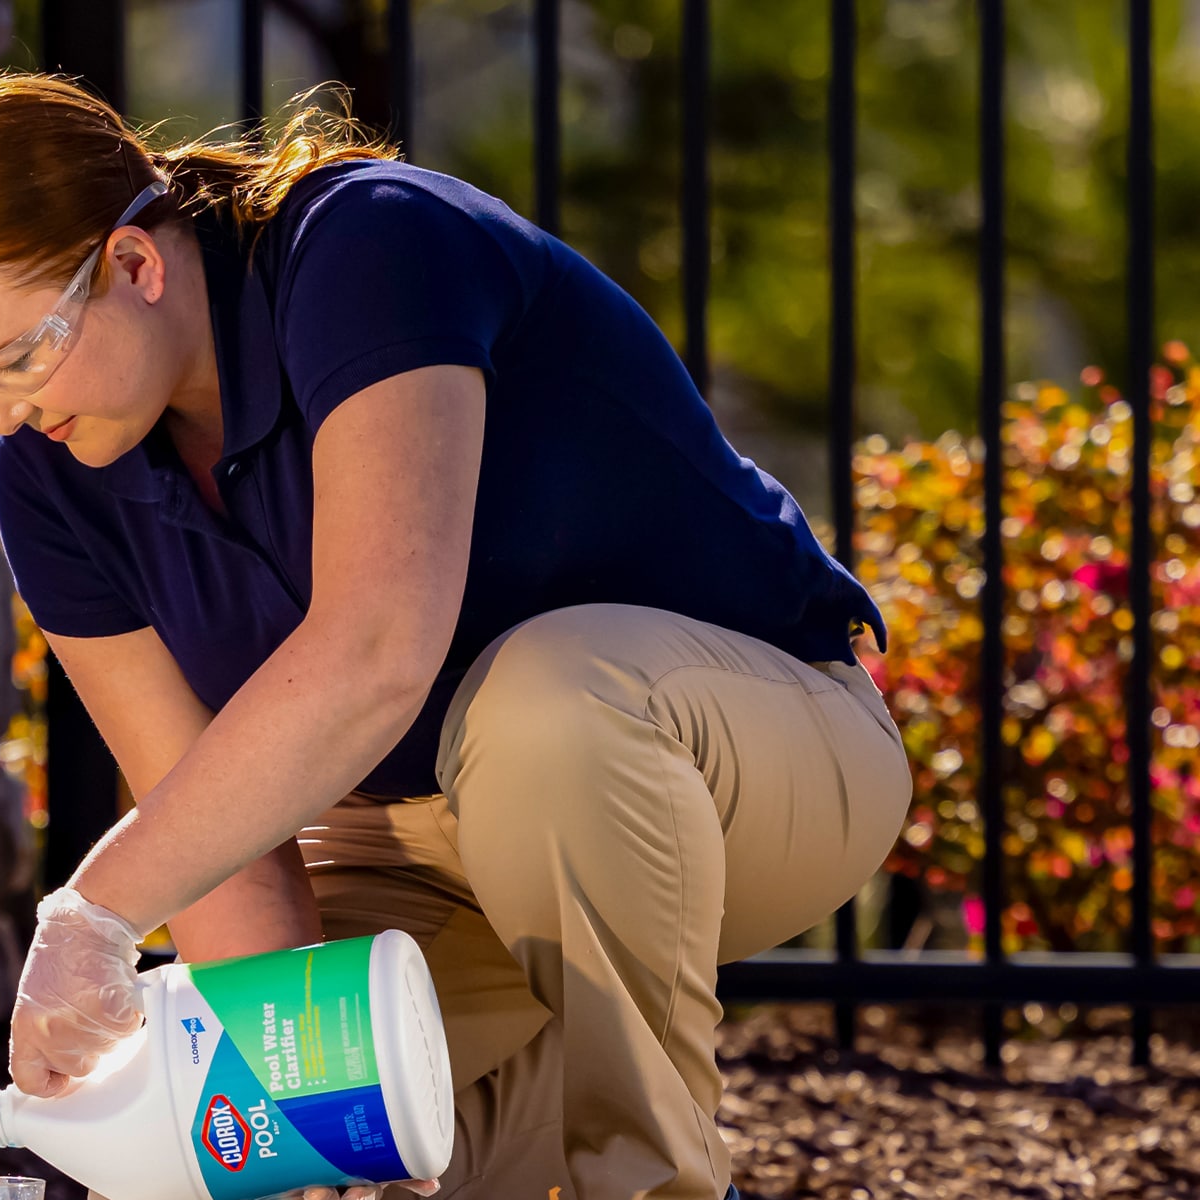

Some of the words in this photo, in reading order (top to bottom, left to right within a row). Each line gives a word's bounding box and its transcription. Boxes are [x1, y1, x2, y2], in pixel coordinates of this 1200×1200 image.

[262, 1003, 278, 1051] Water
[281, 1019, 301, 1090] Clarifier
[264, 1054, 283, 1093] Pool
[211, 1104, 243, 1164] CLOROX
[248, 1099, 278, 1158] POOL
